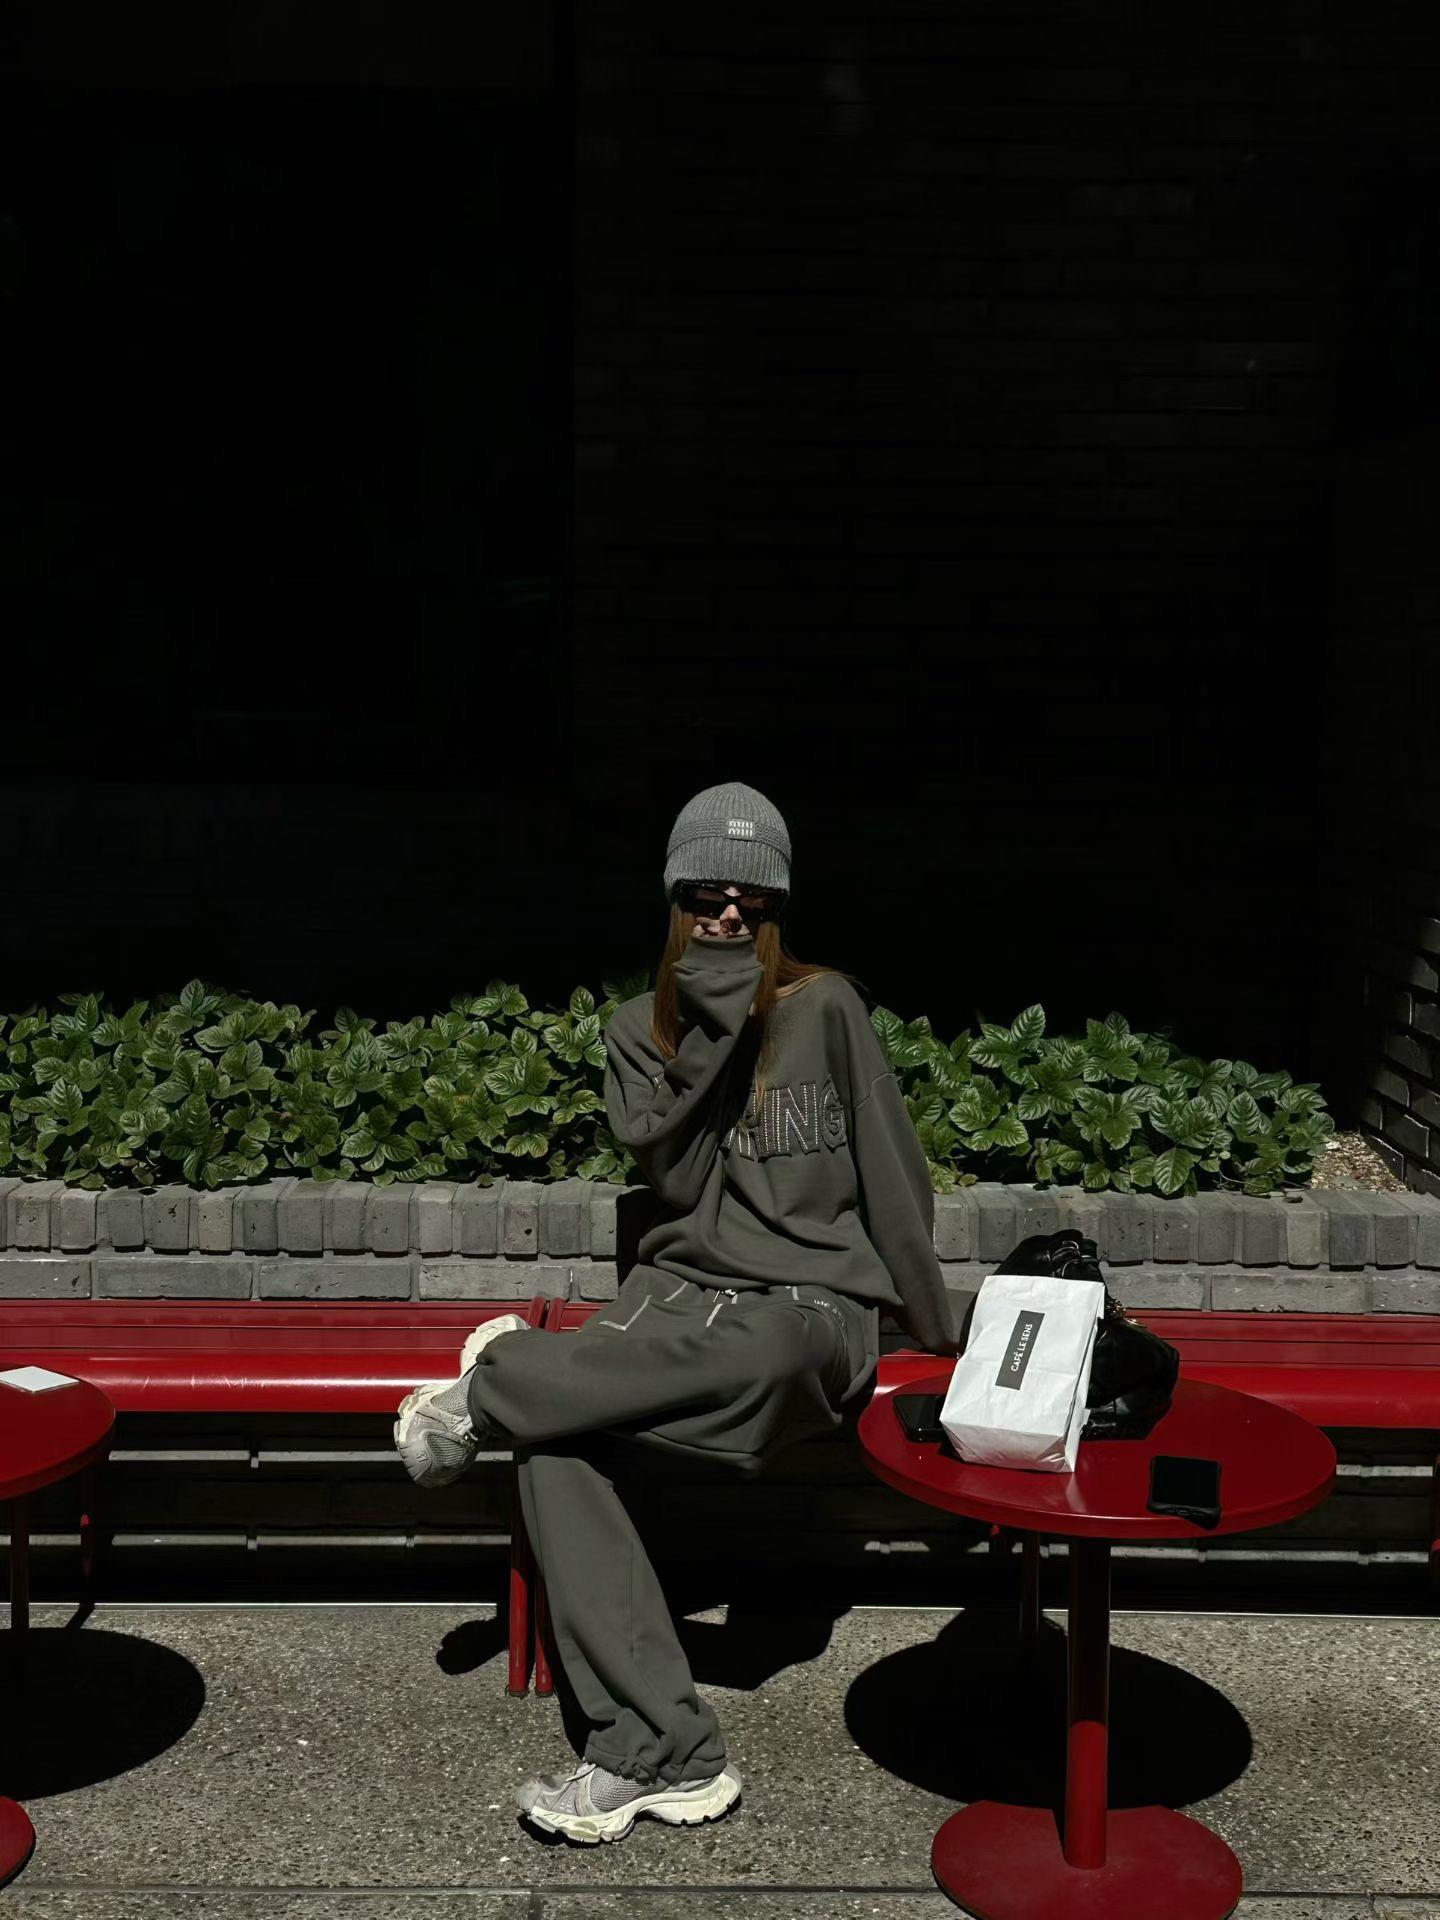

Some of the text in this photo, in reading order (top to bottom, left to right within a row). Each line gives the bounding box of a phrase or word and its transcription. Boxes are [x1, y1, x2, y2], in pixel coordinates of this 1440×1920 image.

[1010, 1323, 1033, 1372] CAFÉ LE SENS
